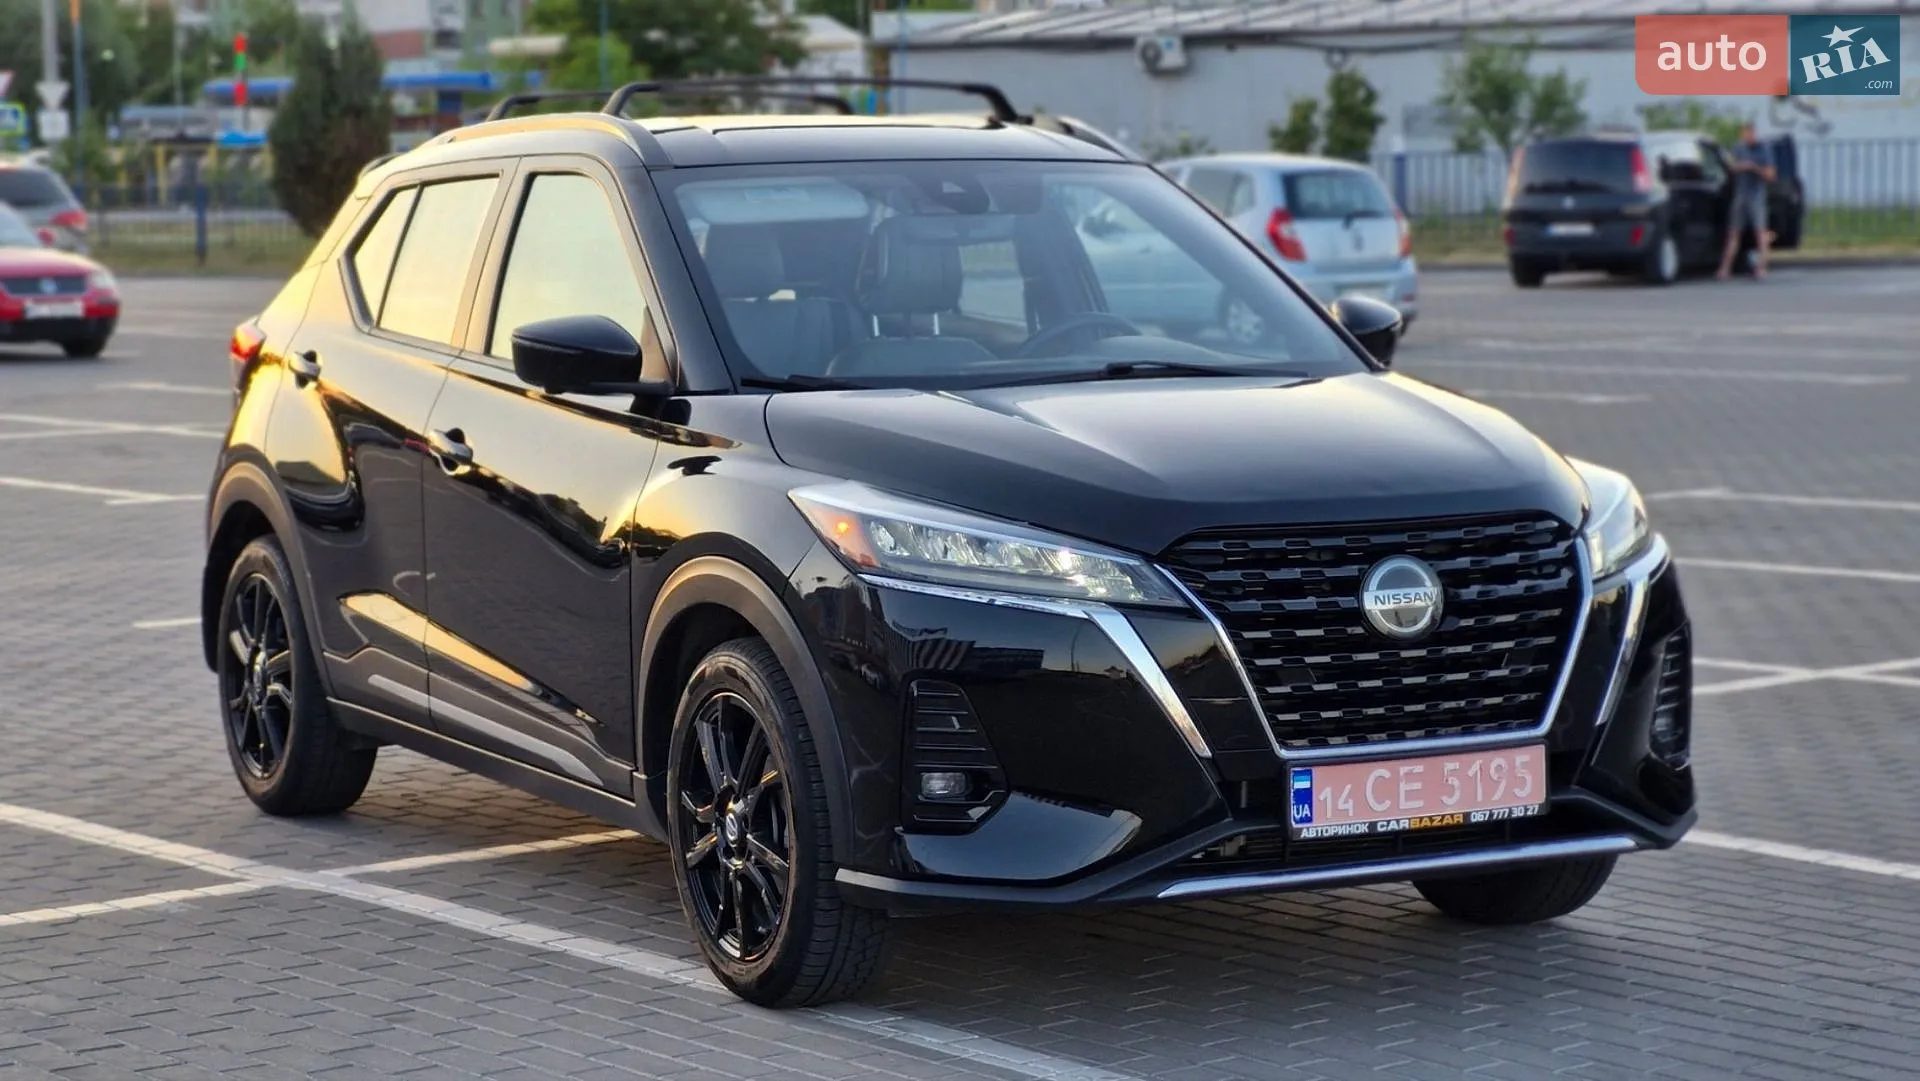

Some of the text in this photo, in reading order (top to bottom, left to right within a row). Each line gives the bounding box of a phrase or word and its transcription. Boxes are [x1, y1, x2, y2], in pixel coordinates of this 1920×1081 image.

[1374, 591, 1434, 606] NISSAN
[1318, 784, 1354, 819] 14
[1440, 754, 1533, 806] 5195
[1293, 803, 1311, 819] UA
[1300, 822, 1369, 839] АВТОРИНОК
[1470, 810, 1489, 823] 067
[1492, 808, 1510, 821] 777
[1511, 807, 1525, 818] 30
[1526, 805, 1539, 817] 27
